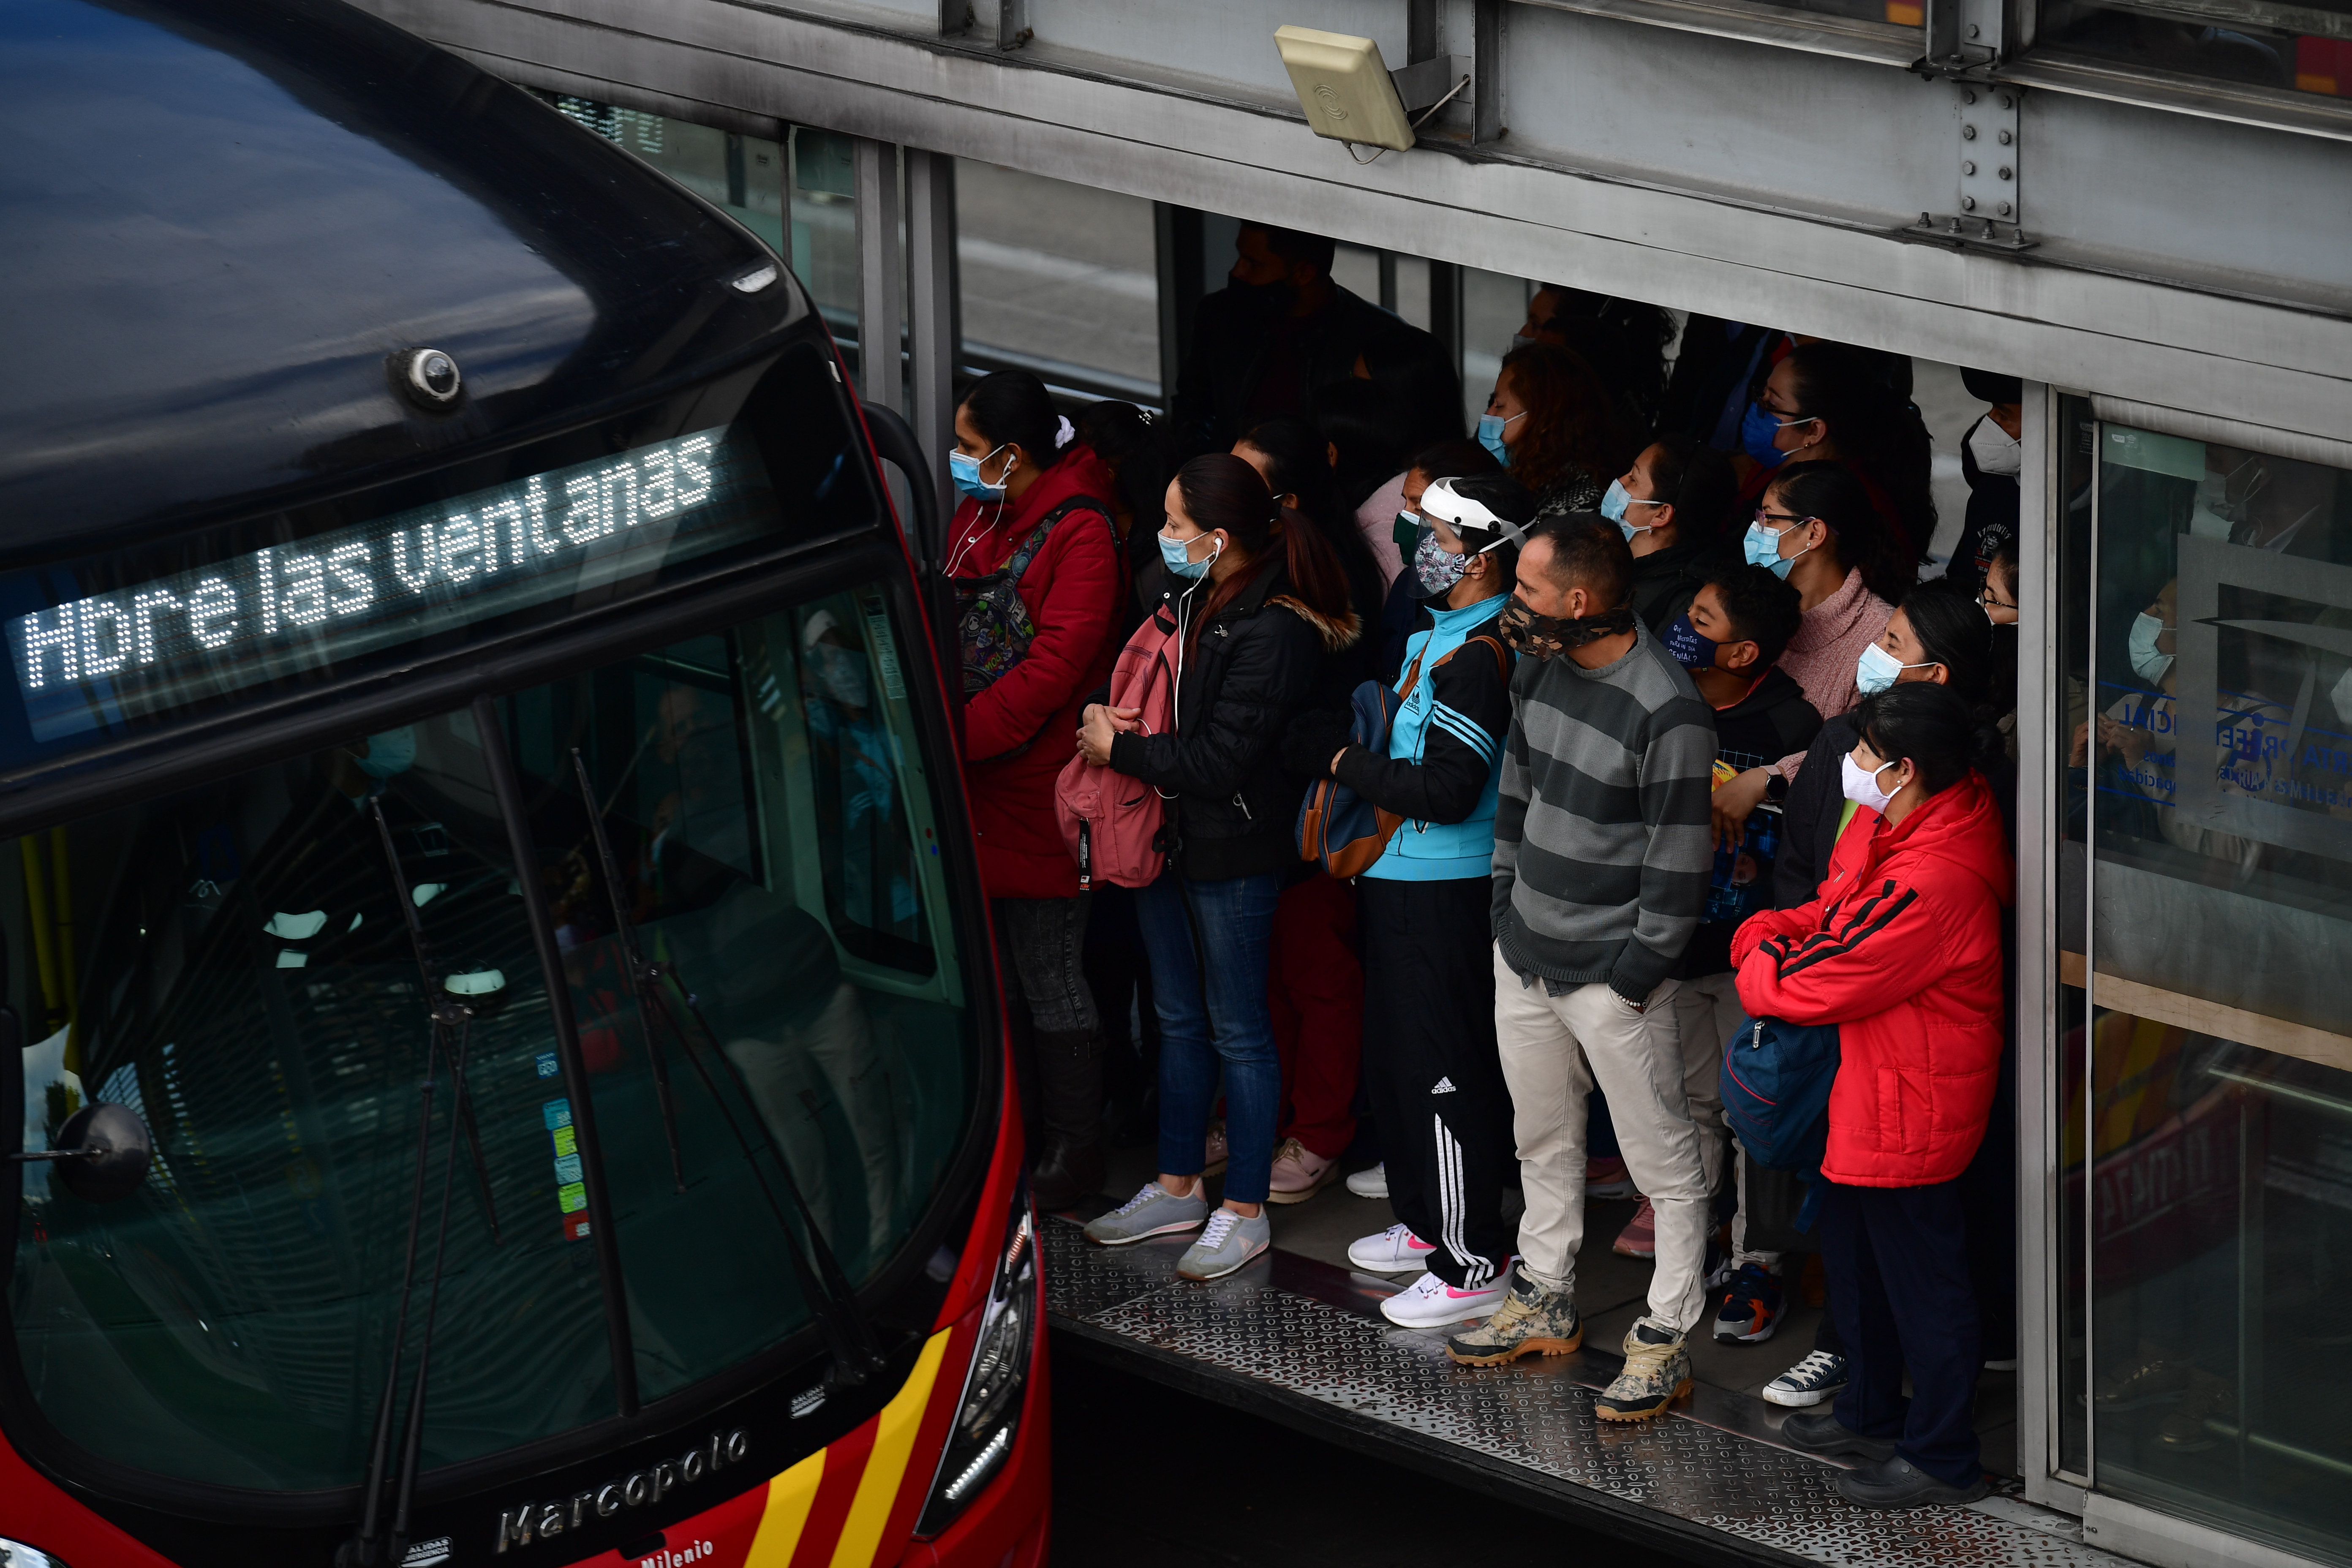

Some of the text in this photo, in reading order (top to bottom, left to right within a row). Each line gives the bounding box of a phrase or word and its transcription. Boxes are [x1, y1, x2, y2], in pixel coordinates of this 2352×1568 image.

[259, 542, 374, 634] las
[391, 437, 713, 593] ventanas
[1677, 634, 1697, 644] NECESITAS
[1431, 1086, 1456, 1094] adidas
[496, 1428, 748, 1554] Marcopolo
[407, 1538, 449, 1554] ALIDAS
